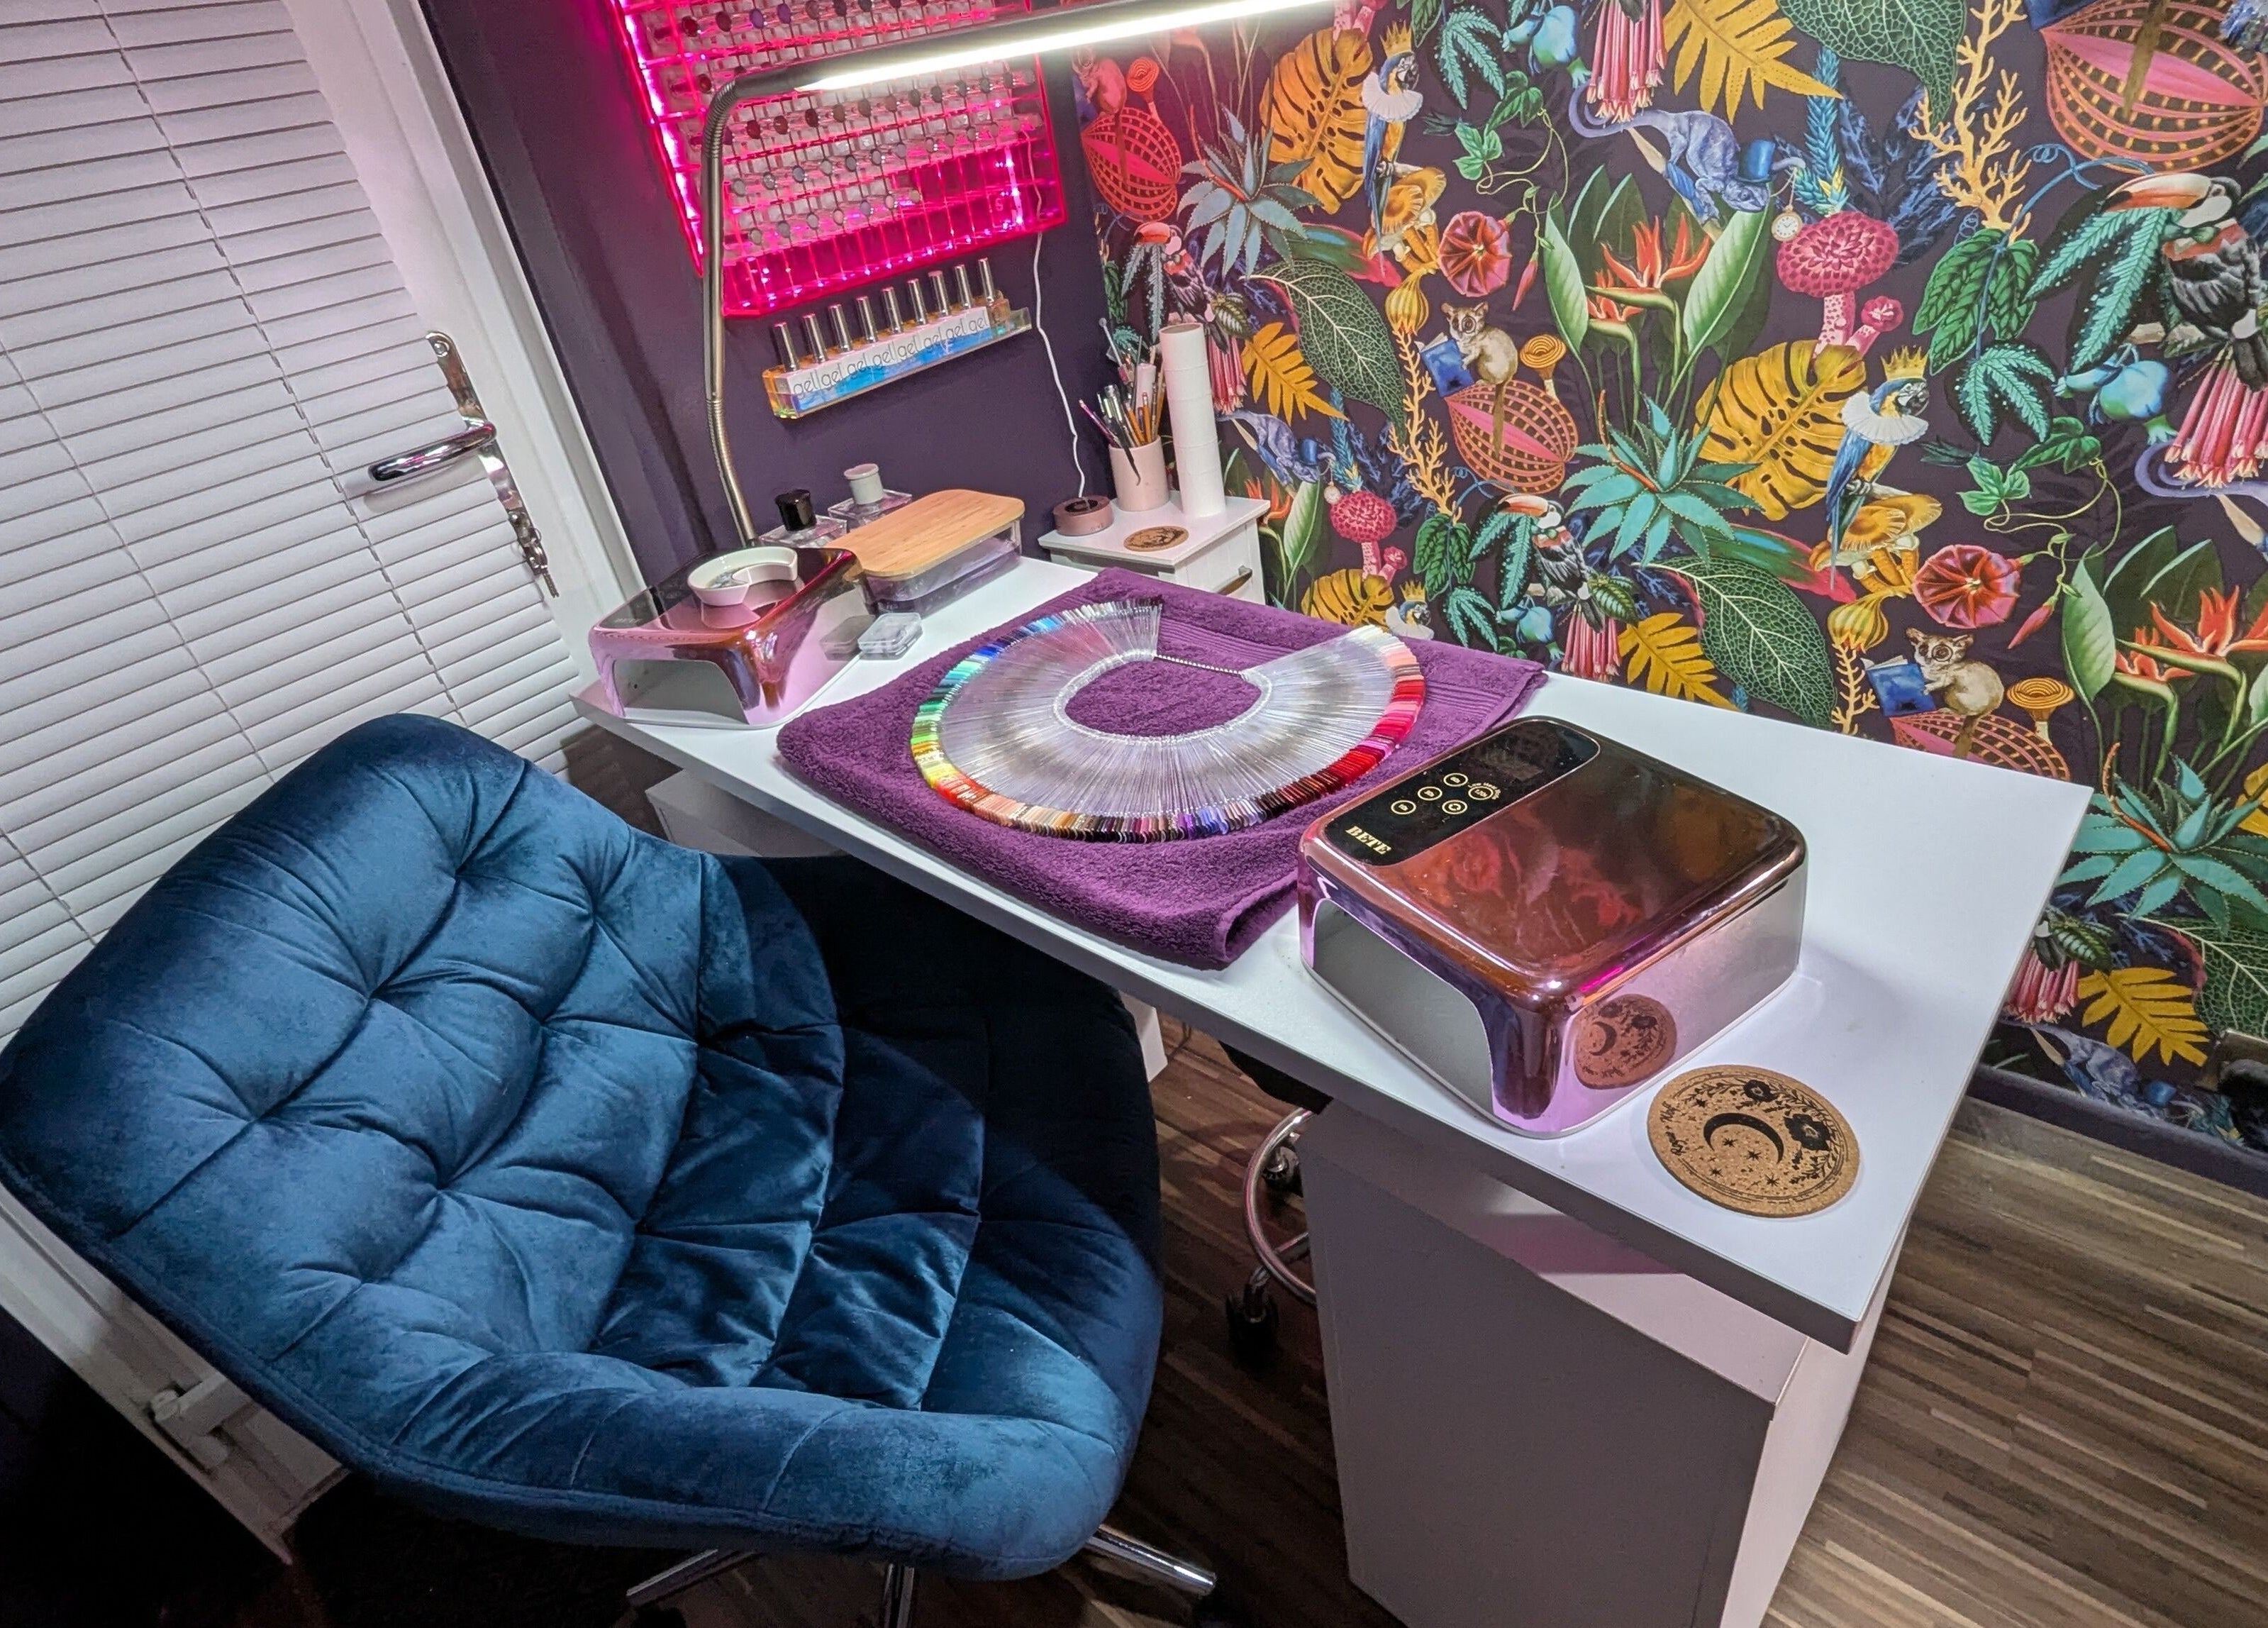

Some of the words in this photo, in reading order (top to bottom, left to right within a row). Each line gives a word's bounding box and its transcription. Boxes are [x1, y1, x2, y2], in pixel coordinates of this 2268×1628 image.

[946, 318, 966, 343] gel
[969, 309, 988, 336] gel
[898, 335, 918, 360] gel
[923, 327, 943, 353] gel
[847, 353, 867, 380] gel
[873, 344, 894, 370] gel
[793, 372, 817, 399] gel
[821, 362, 843, 391] gel
[1345, 826, 1392, 855] BETE
